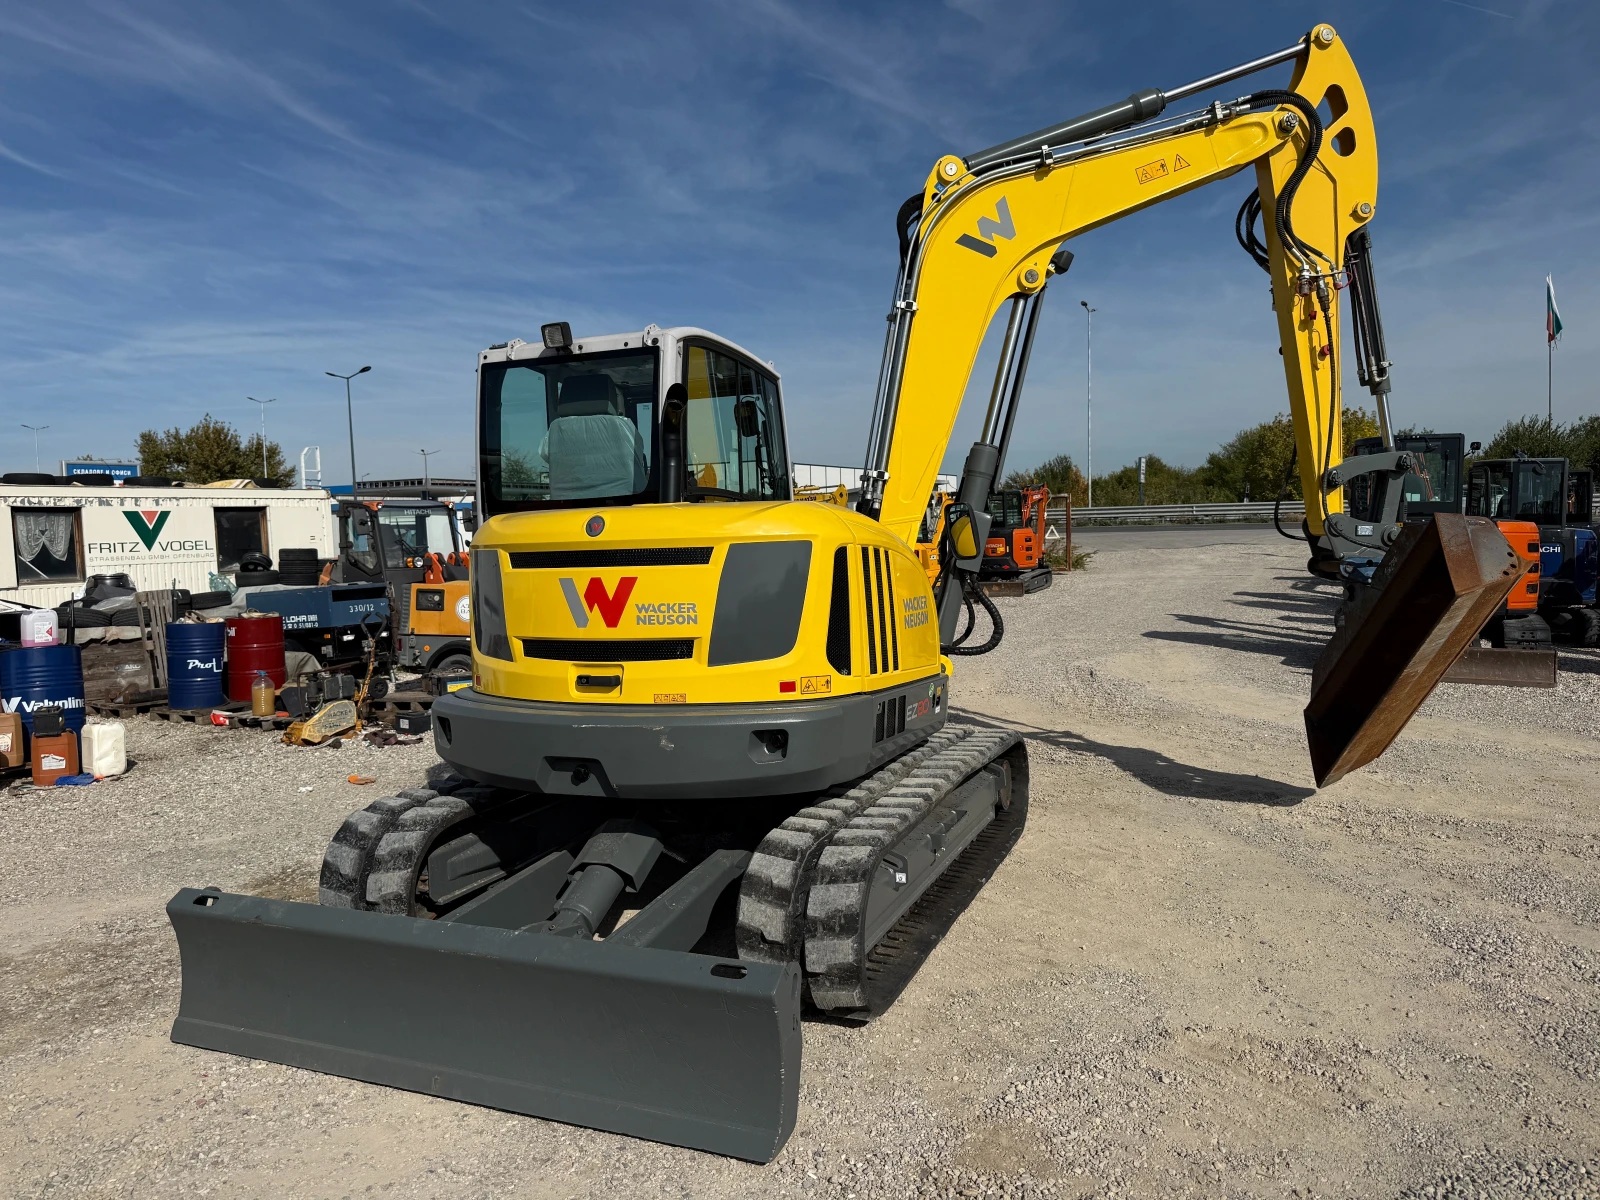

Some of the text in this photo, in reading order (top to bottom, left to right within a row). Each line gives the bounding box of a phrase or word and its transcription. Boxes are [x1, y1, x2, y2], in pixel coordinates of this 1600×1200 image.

[88, 540, 214, 554] FRITZ VOGEL
[89, 554, 146, 563] STRASSENBAU
[173, 552, 215, 560] OFFENBURG
[349, 604, 375, 613] 330/12
[635, 602, 697, 614] WACKER
[903, 595, 928, 613] WACKER
[636, 614, 698, 625] NEUSON
[904, 611, 929, 630] NEUSON
[906, 698, 930, 721] EZ80
